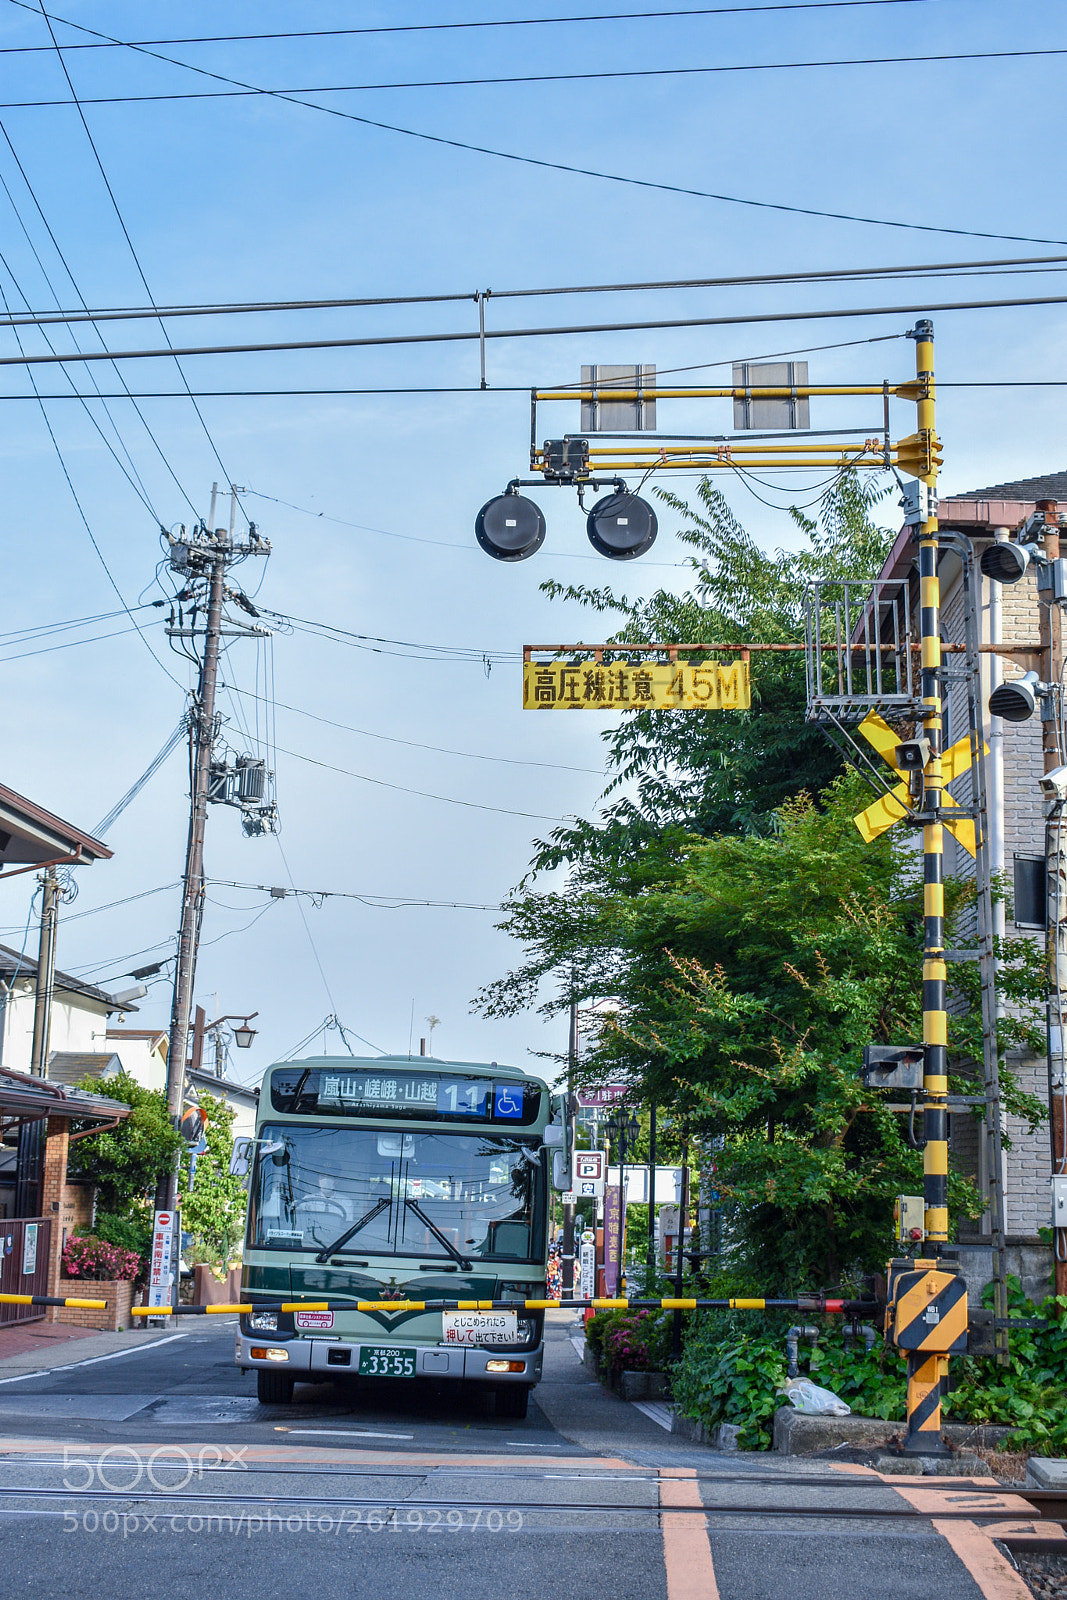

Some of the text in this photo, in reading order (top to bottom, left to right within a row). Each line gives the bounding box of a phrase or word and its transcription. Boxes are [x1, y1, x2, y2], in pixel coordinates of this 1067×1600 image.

[535, 669, 656, 702] 高圧線注意
[323, 1076, 438, 1102] 嵐山・嵯峨・山越
[444, 1084, 480, 1113] 11
[584, 1166, 594, 1175] P
[453, 1317, 506, 1328] とじこめられたら
[369, 1356, 414, 1375] 33-55
